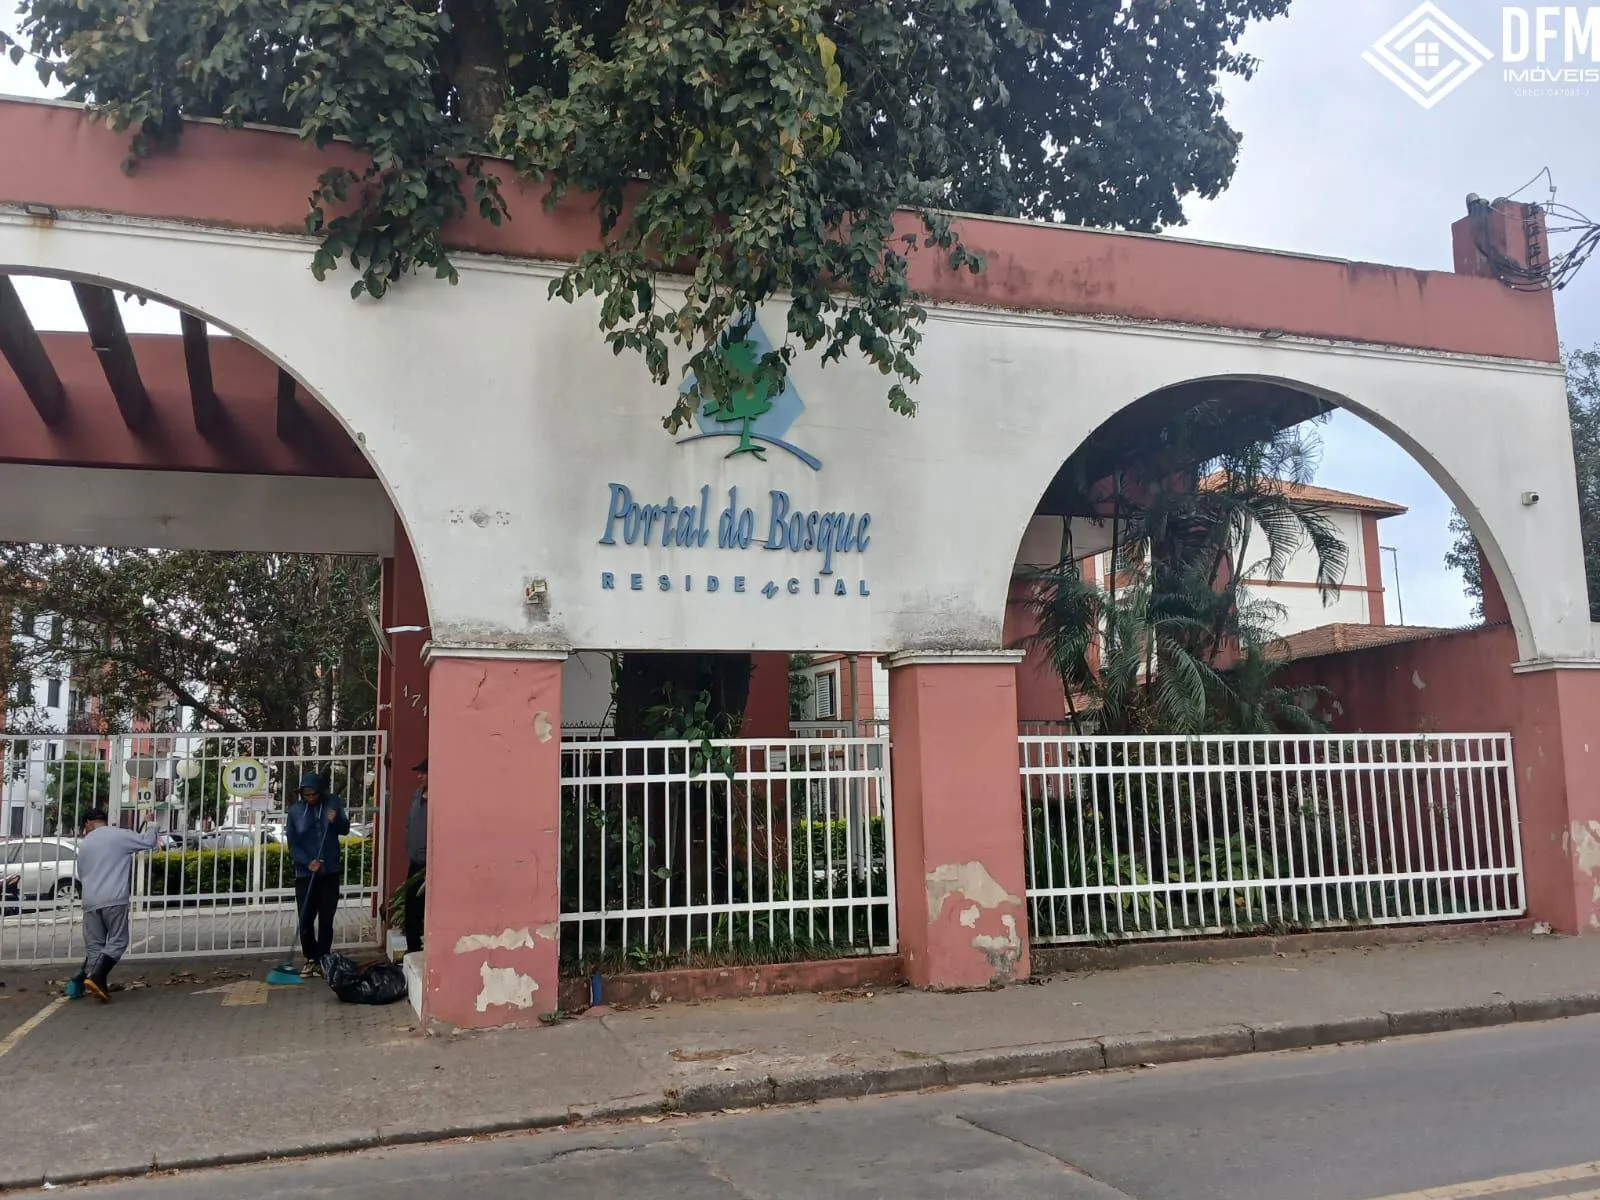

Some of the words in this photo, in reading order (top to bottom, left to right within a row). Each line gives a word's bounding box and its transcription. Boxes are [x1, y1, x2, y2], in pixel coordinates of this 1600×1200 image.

[598, 482, 711, 548] Portal
[718, 485, 755, 549] do
[763, 489, 872, 575] Bosque
[601, 572, 871, 599] RESIDENCIAL
[231, 766, 257, 781] 10
[138, 791, 151, 801] 10
